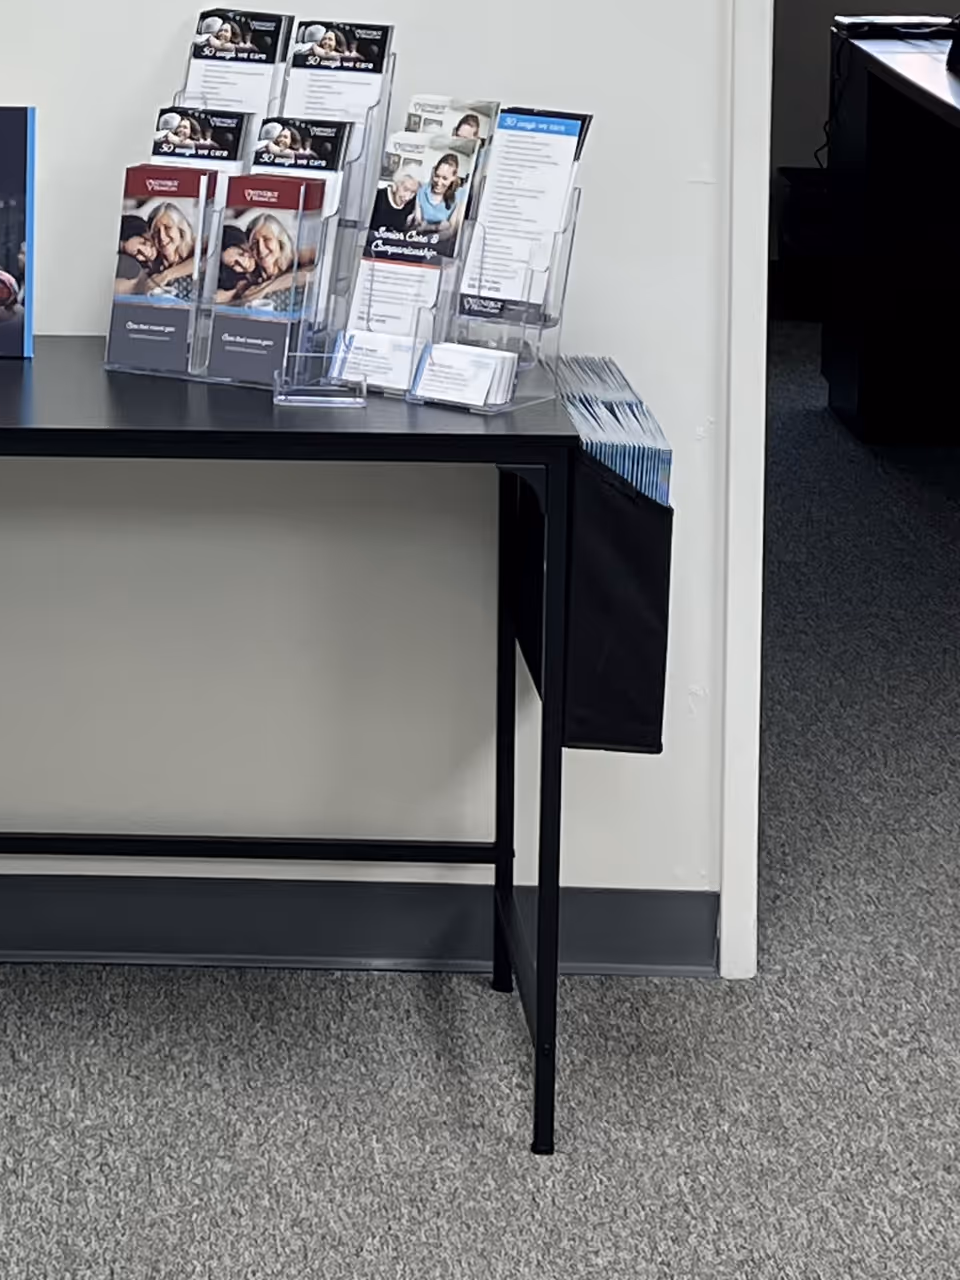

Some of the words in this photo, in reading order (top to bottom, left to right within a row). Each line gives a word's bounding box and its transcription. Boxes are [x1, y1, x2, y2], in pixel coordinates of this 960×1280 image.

[201, 46, 215, 57] 50
[305, 55, 320, 66] 50
[159, 143, 174, 153] 50
[259, 152, 275, 162] 50
[406, 230, 429, 243] Care
